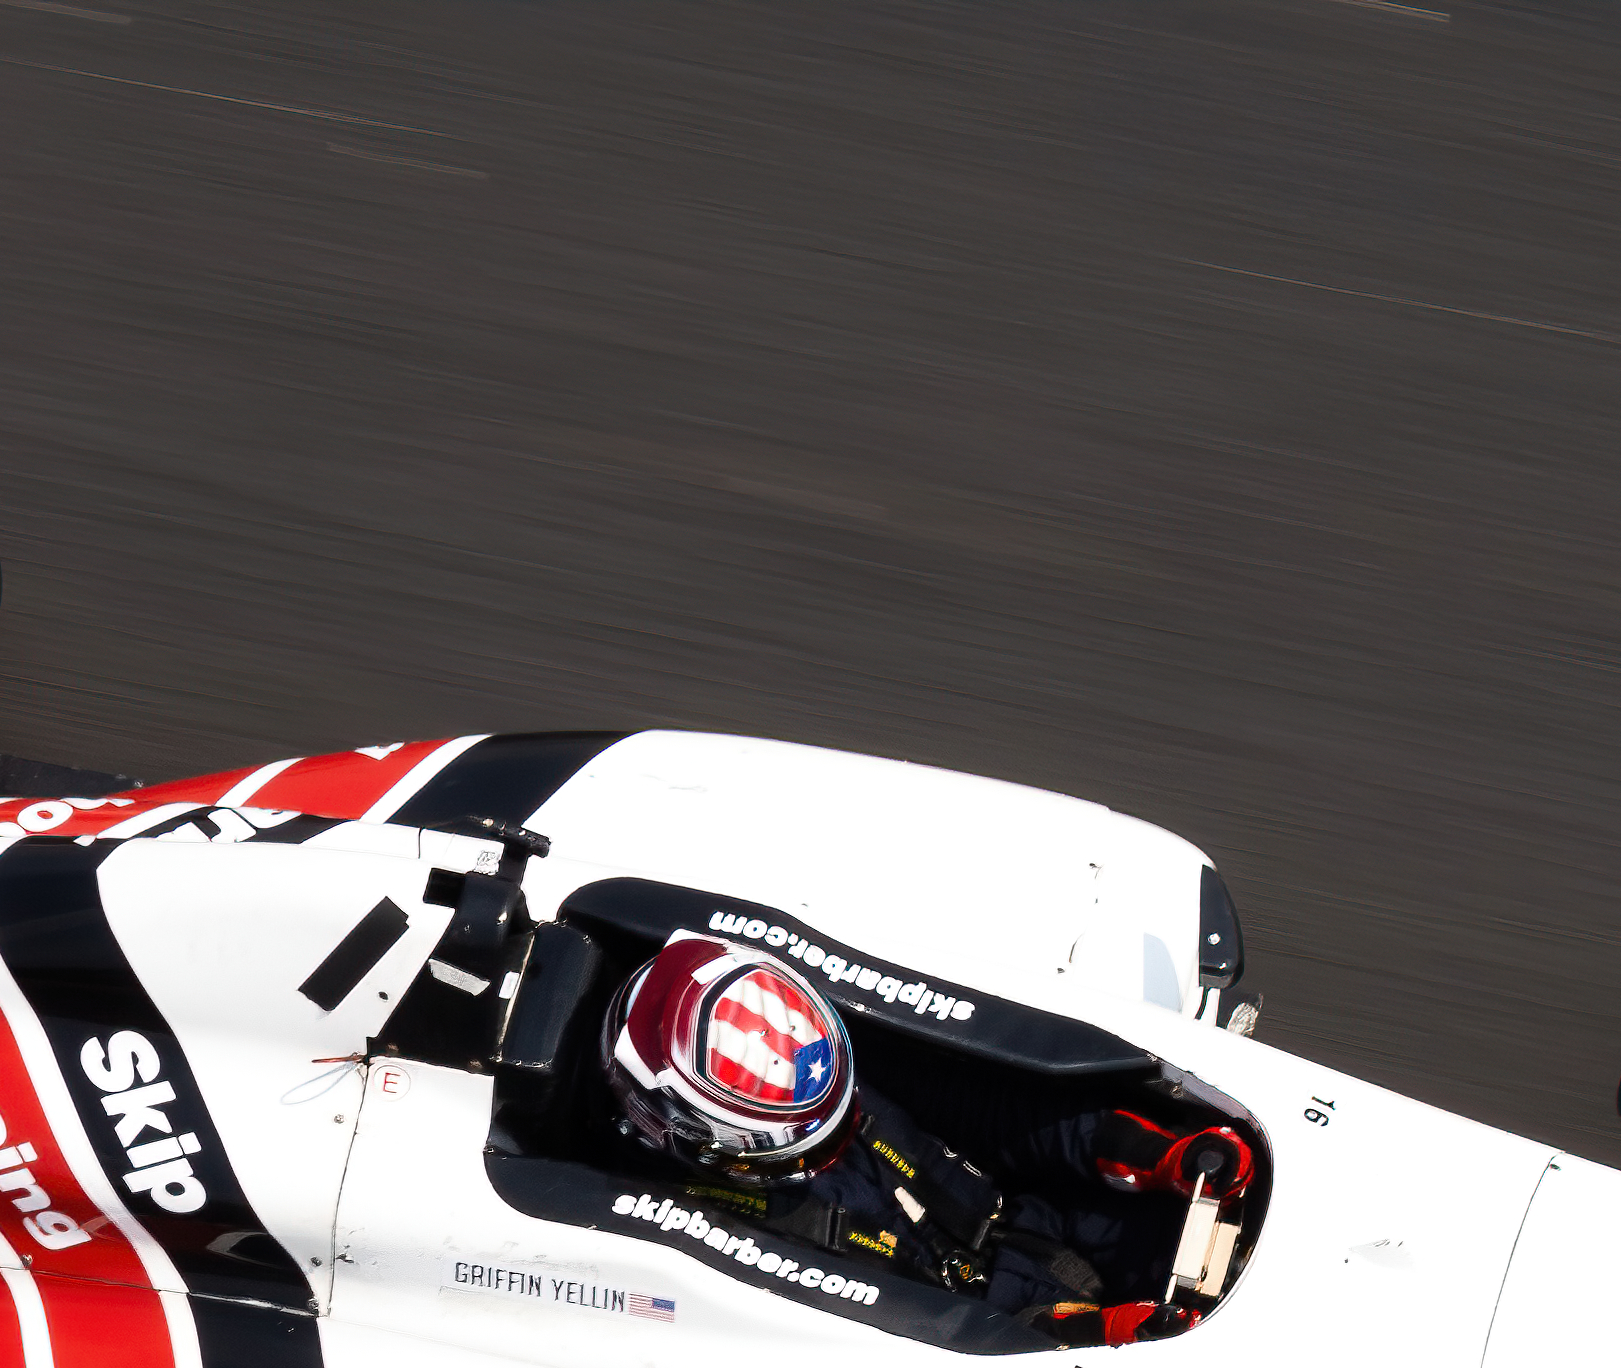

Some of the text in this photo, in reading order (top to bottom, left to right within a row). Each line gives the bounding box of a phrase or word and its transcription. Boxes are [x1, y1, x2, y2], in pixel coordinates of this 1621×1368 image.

[709, 911, 976, 1021] skipbarber.com
[80, 1029, 208, 1214] Skip
[382, 1072, 400, 1094] E
[1304, 1096, 1336, 1126] 16
[454, 1261, 626, 1312] GRIFFIN YELLIN
[611, 1193, 880, 1306] skipbarber.com
